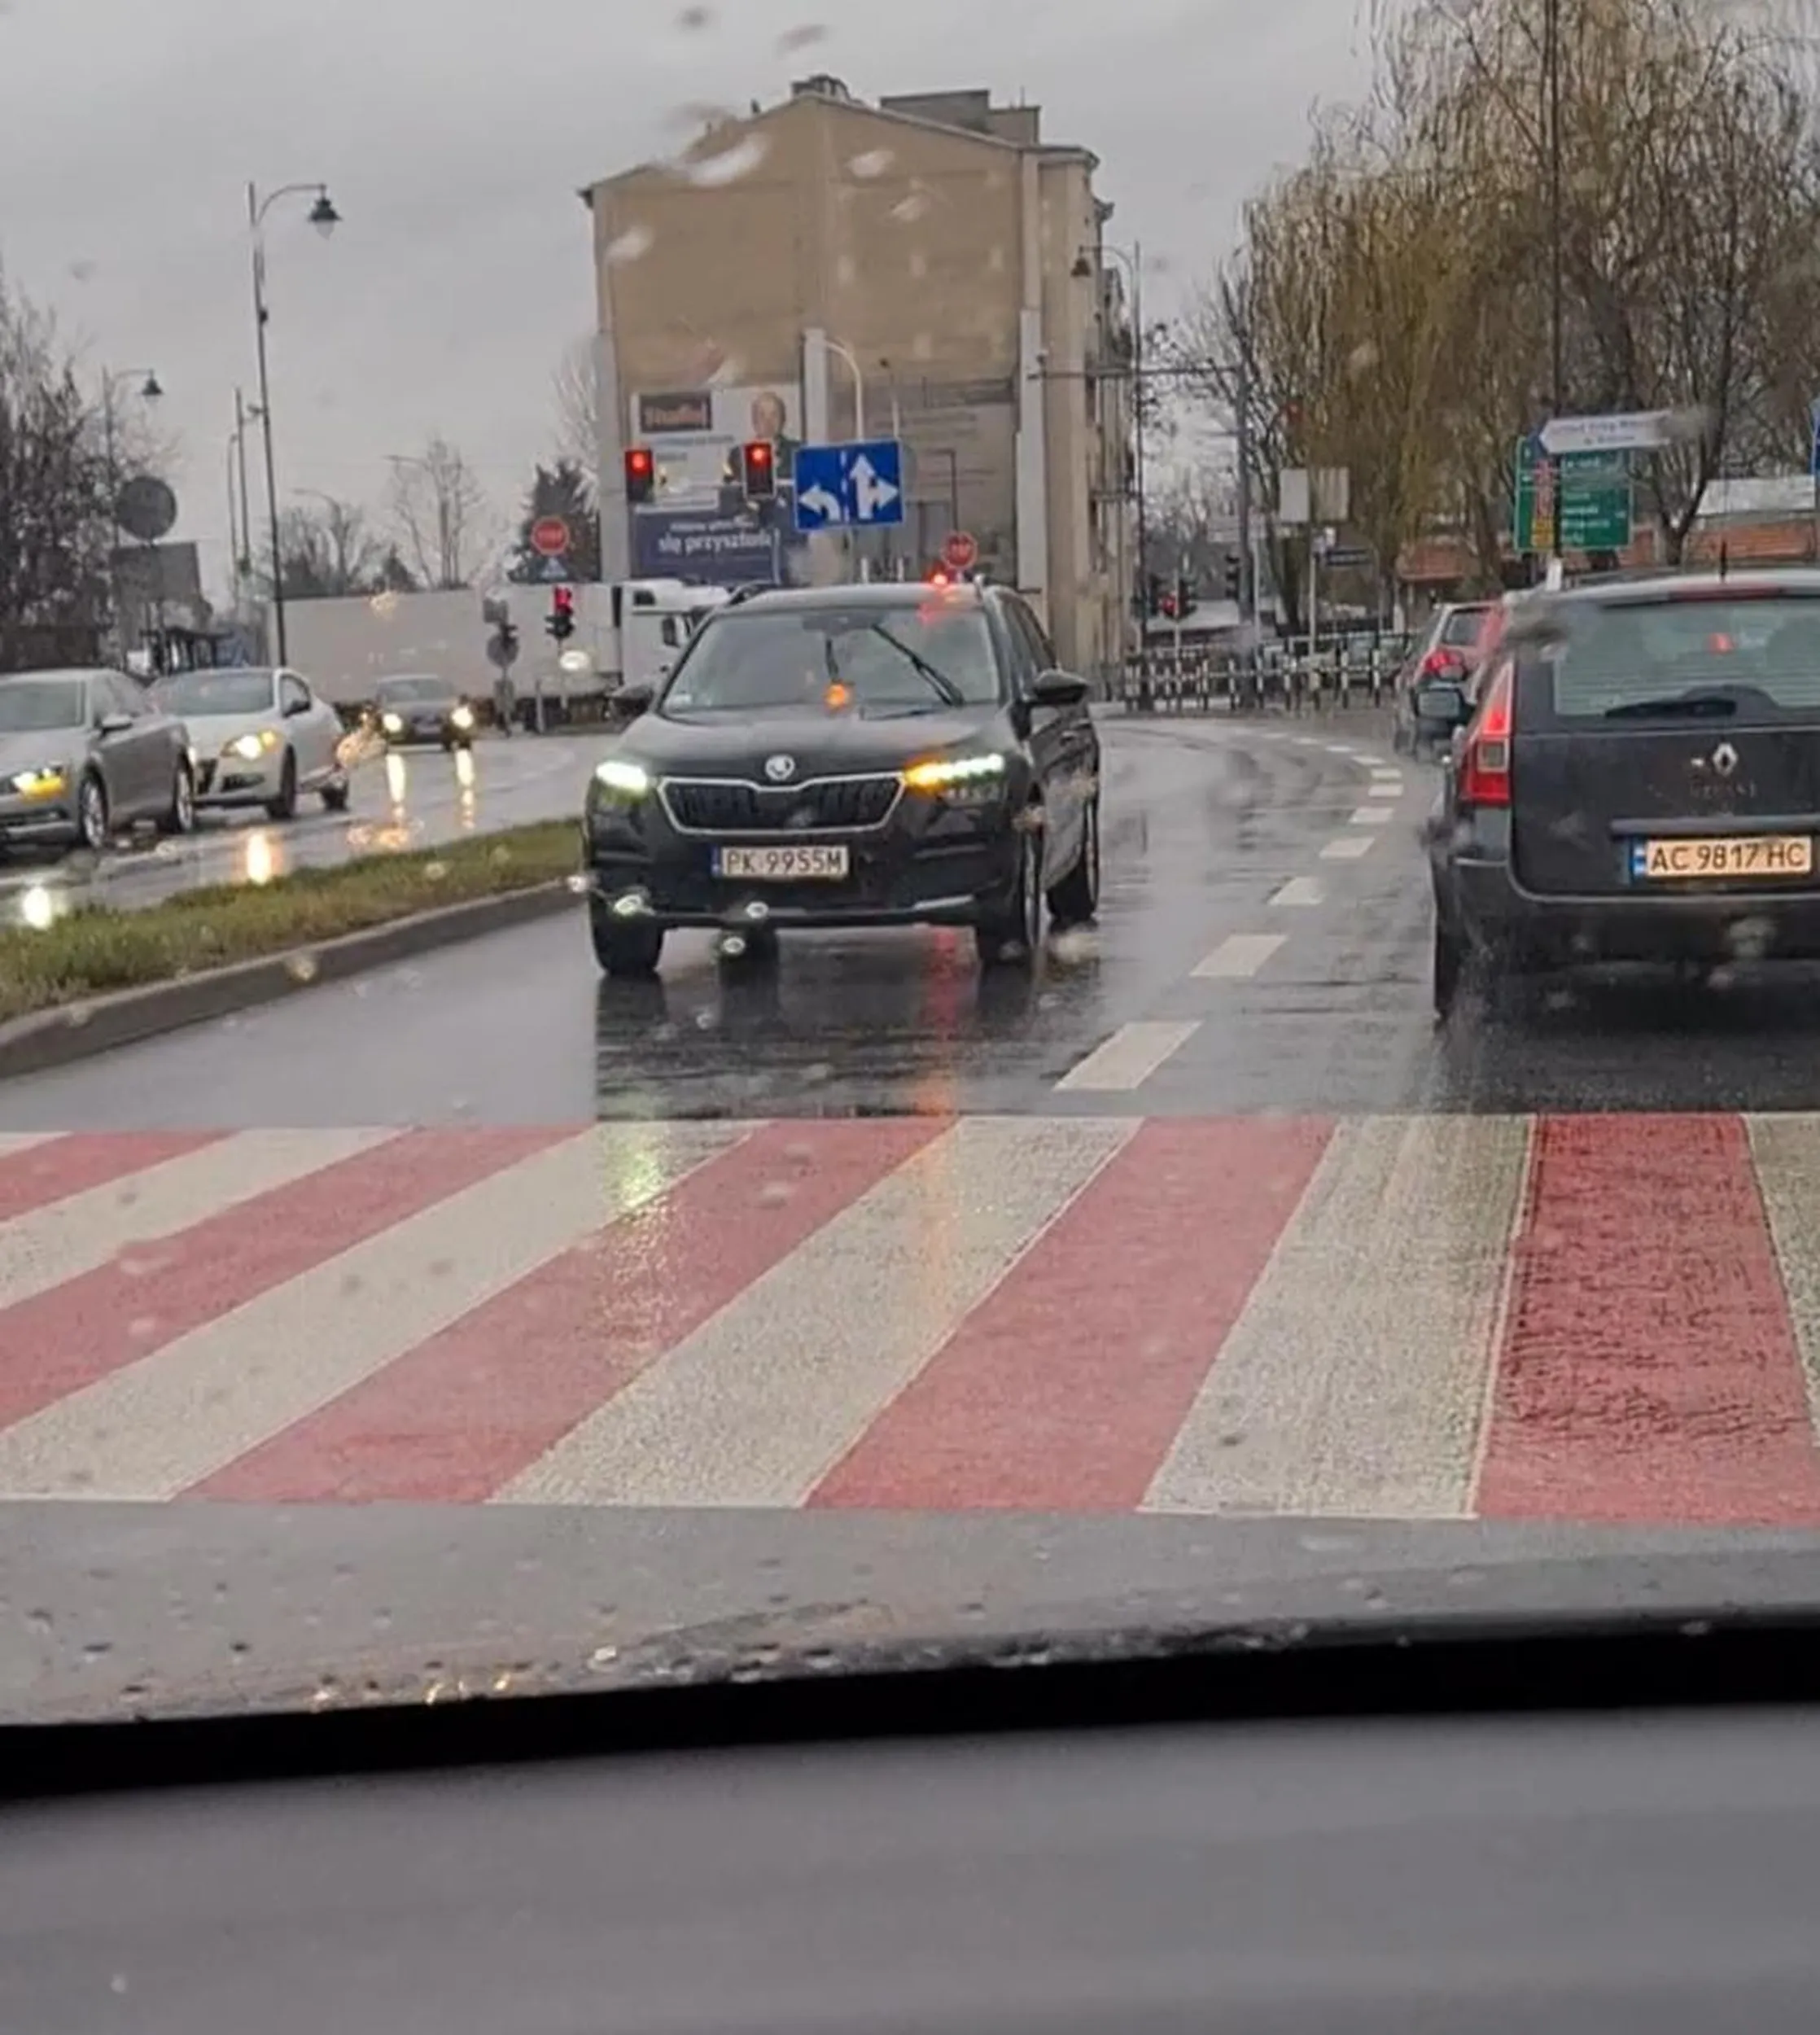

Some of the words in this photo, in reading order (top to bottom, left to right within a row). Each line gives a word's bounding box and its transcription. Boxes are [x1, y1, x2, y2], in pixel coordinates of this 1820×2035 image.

[727, 849, 755, 875] PK
[766, 848, 842, 874] 9955M
[1651, 847, 1689, 872] AC
[1696, 843, 1758, 870] 9817
[1766, 842, 1805, 868] HC
